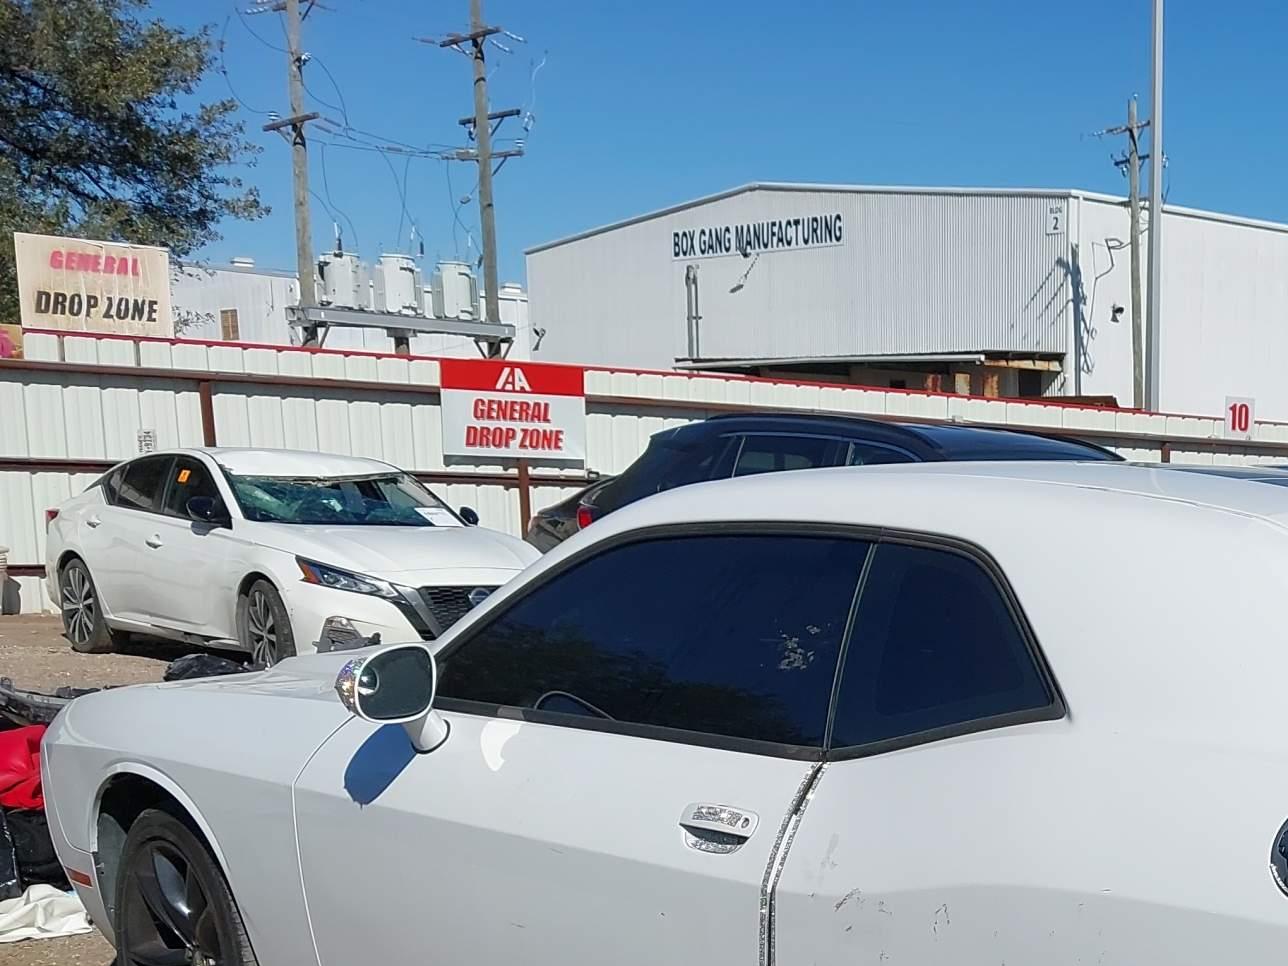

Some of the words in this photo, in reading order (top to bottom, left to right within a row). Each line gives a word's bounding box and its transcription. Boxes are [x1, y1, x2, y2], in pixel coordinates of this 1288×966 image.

[672, 229, 696, 257] BOX
[698, 226, 732, 255] GANG
[735, 213, 843, 253] MANUFACTURING
[1052, 216, 1060, 231] 2
[49, 249, 141, 277] GENERAL
[34, 290, 99, 319] DROP
[102, 296, 158, 323] ZONE
[473, 398, 552, 424] GENERAL
[1229, 403, 1249, 432] 10
[465, 425, 517, 449] DROP
[518, 428, 564, 451] ZONE
